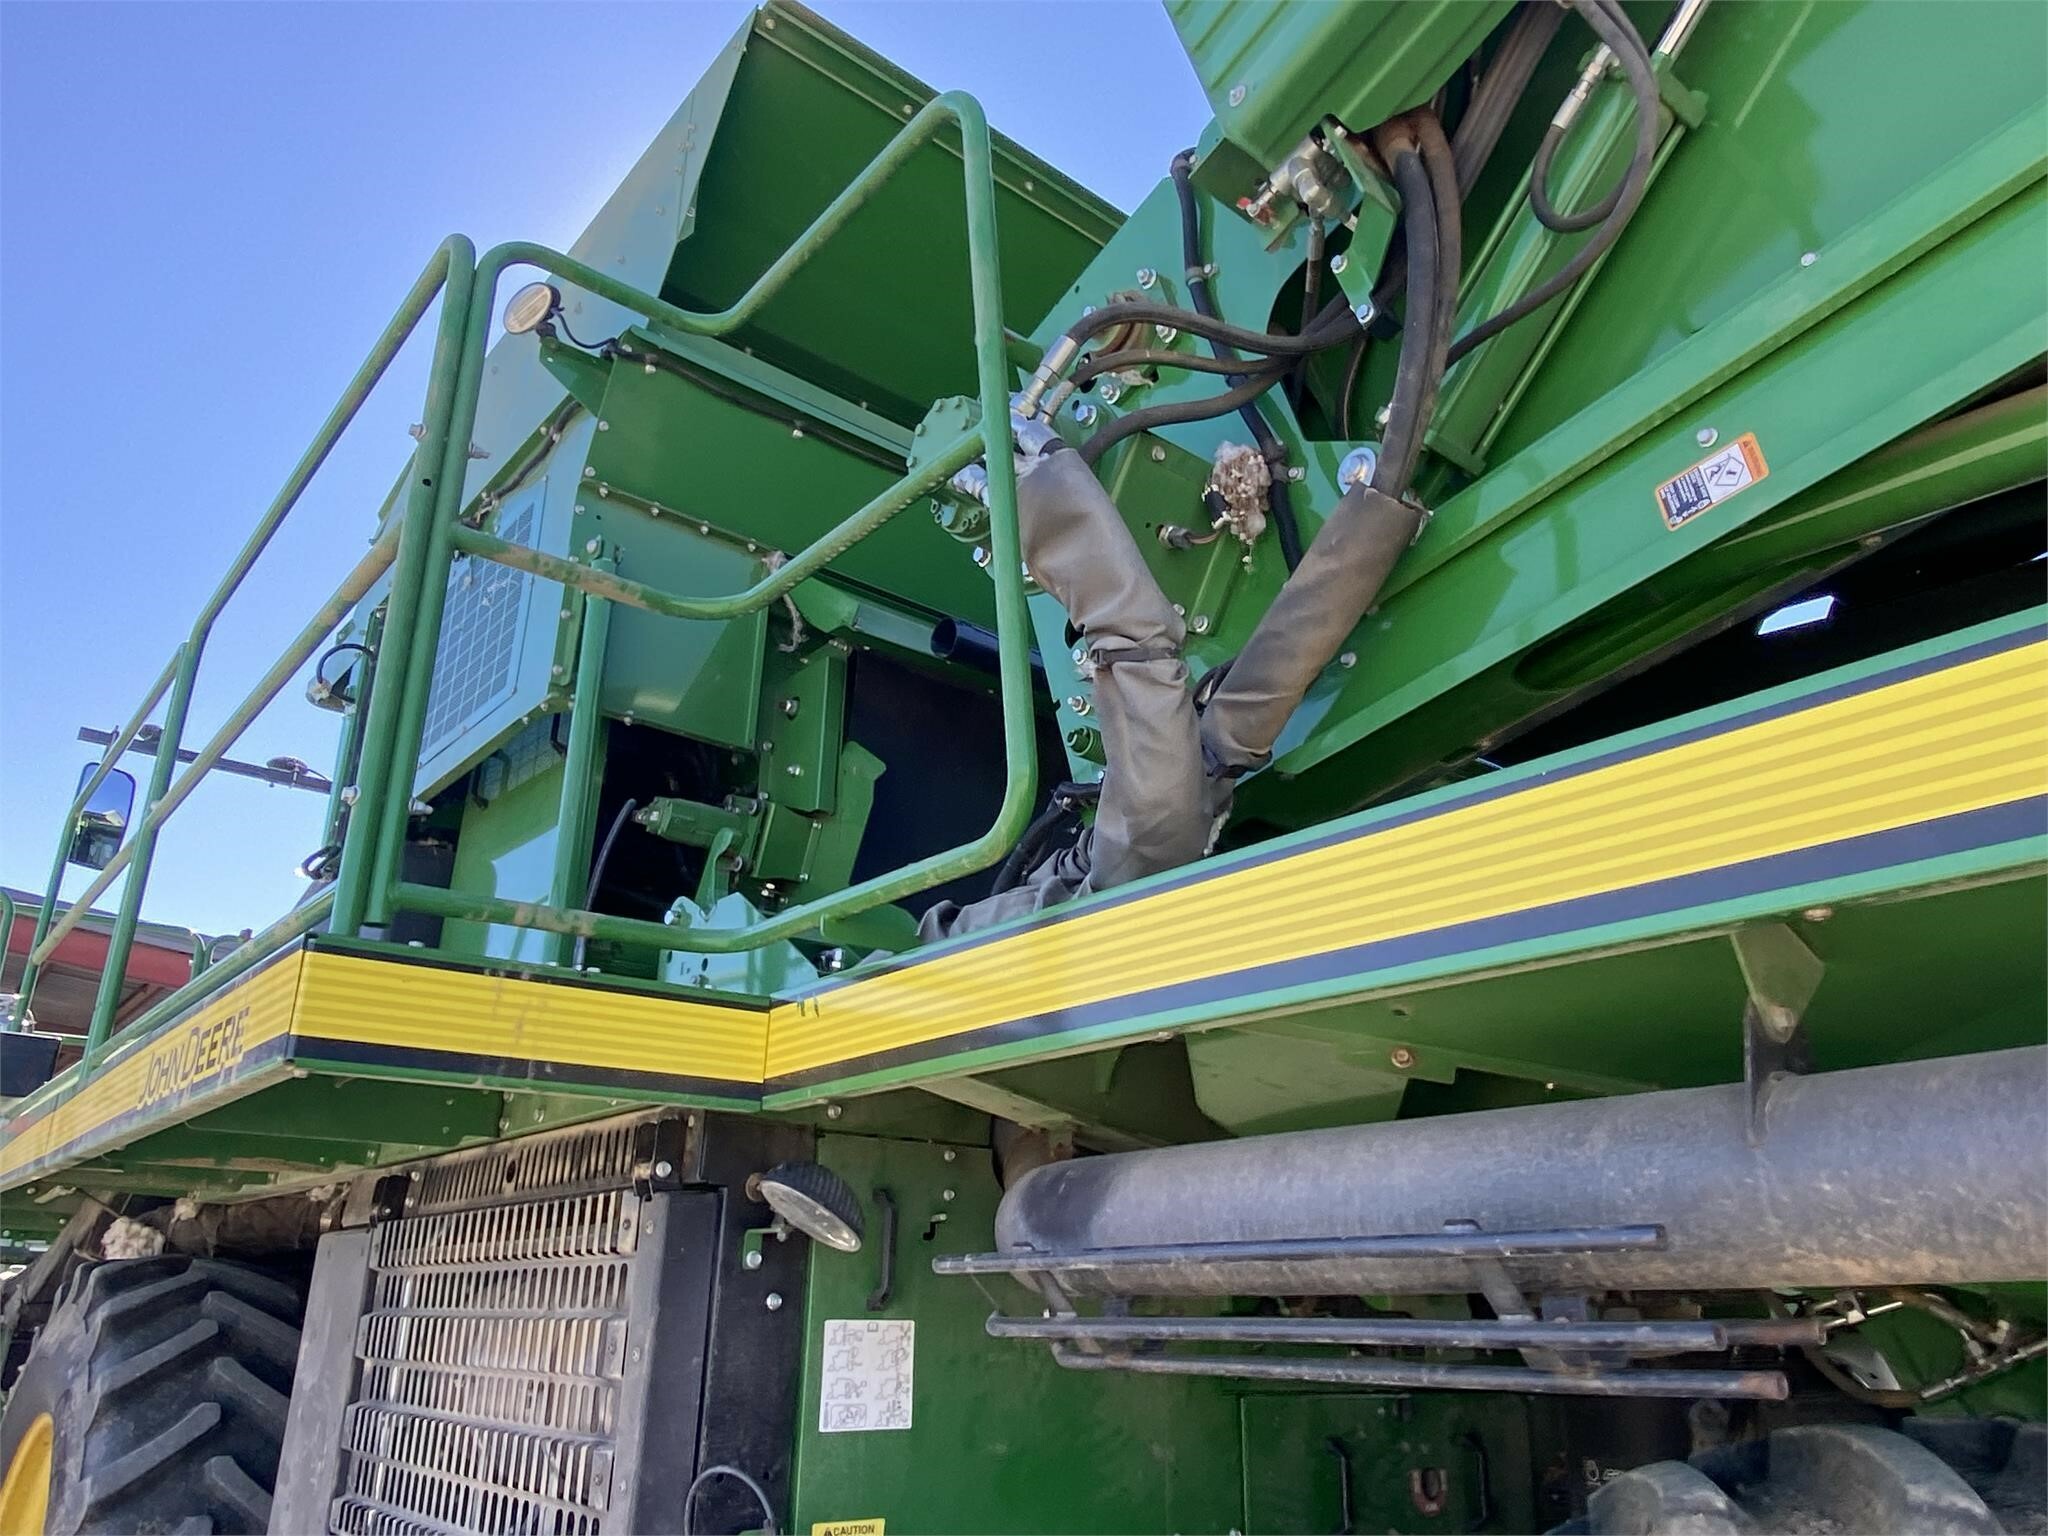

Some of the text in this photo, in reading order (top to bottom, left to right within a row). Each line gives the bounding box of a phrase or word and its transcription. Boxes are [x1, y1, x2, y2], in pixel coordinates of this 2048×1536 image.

[138, 1006, 250, 1104] JOHN DEERE
[833, 1524, 875, 1536] CAUTION
